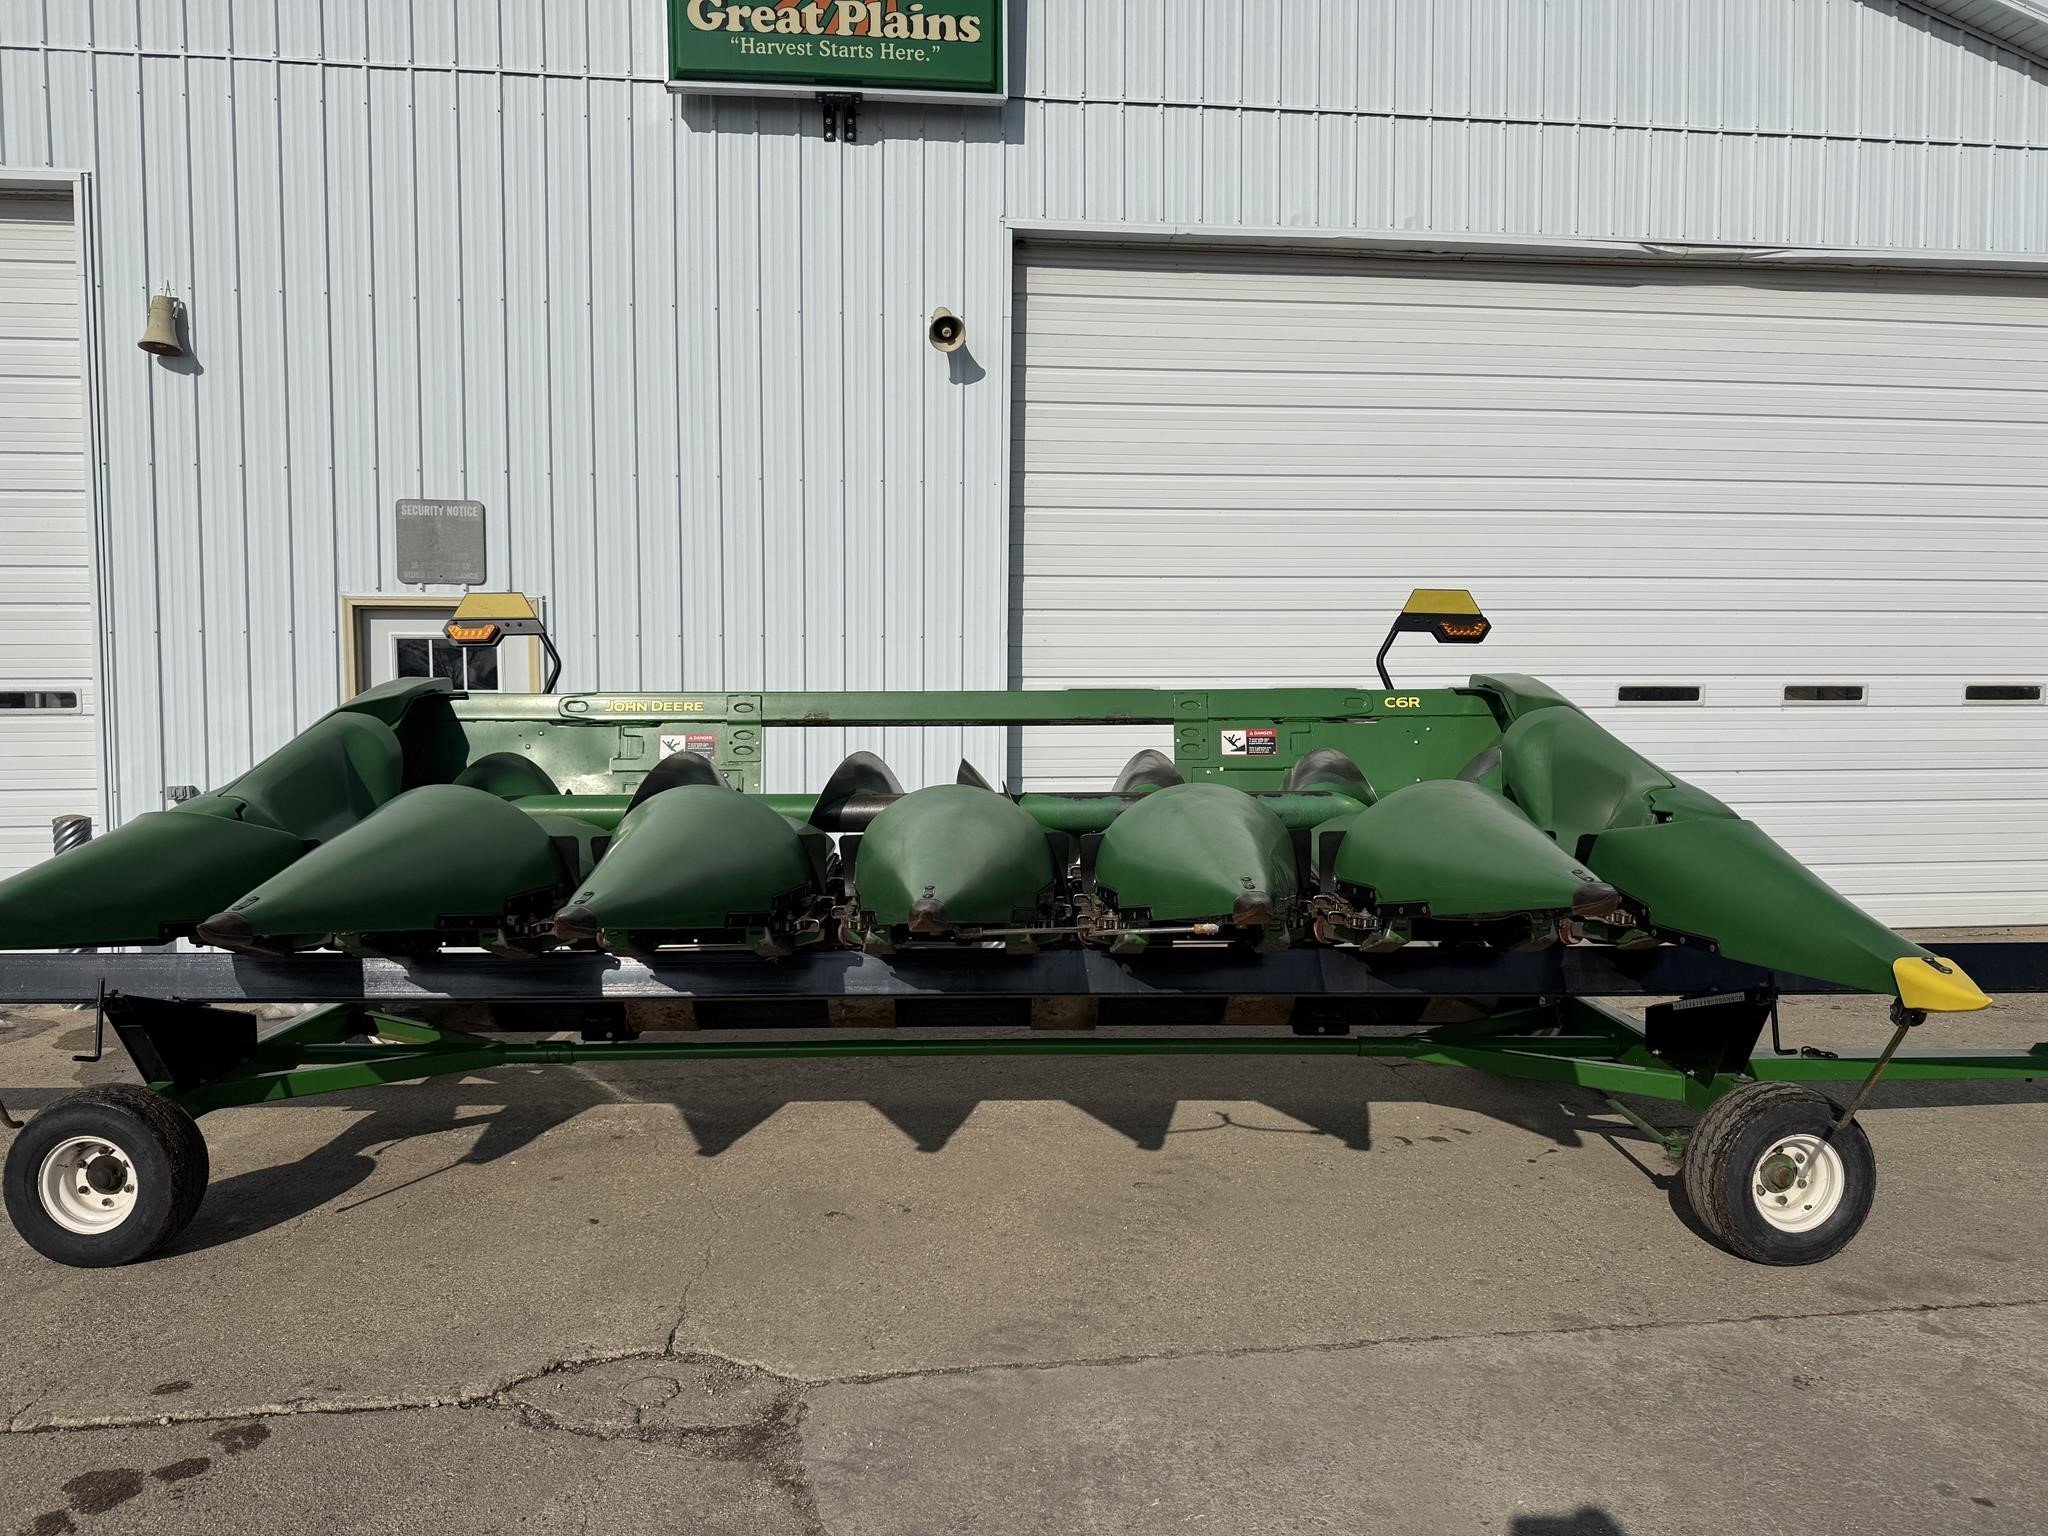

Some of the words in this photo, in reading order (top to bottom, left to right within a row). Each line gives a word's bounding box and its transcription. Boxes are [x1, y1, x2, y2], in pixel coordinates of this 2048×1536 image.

[687, 0, 824, 35] Great
[836, 0, 981, 42] Plains
[819, 40, 874, 59] Starts
[401, 505, 444, 516] SECURITY
[446, 506, 479, 517] NOTICE
[605, 700, 647, 712] JOHN
[651, 700, 704, 712] DEERE
[1384, 696, 1421, 709] C6R
